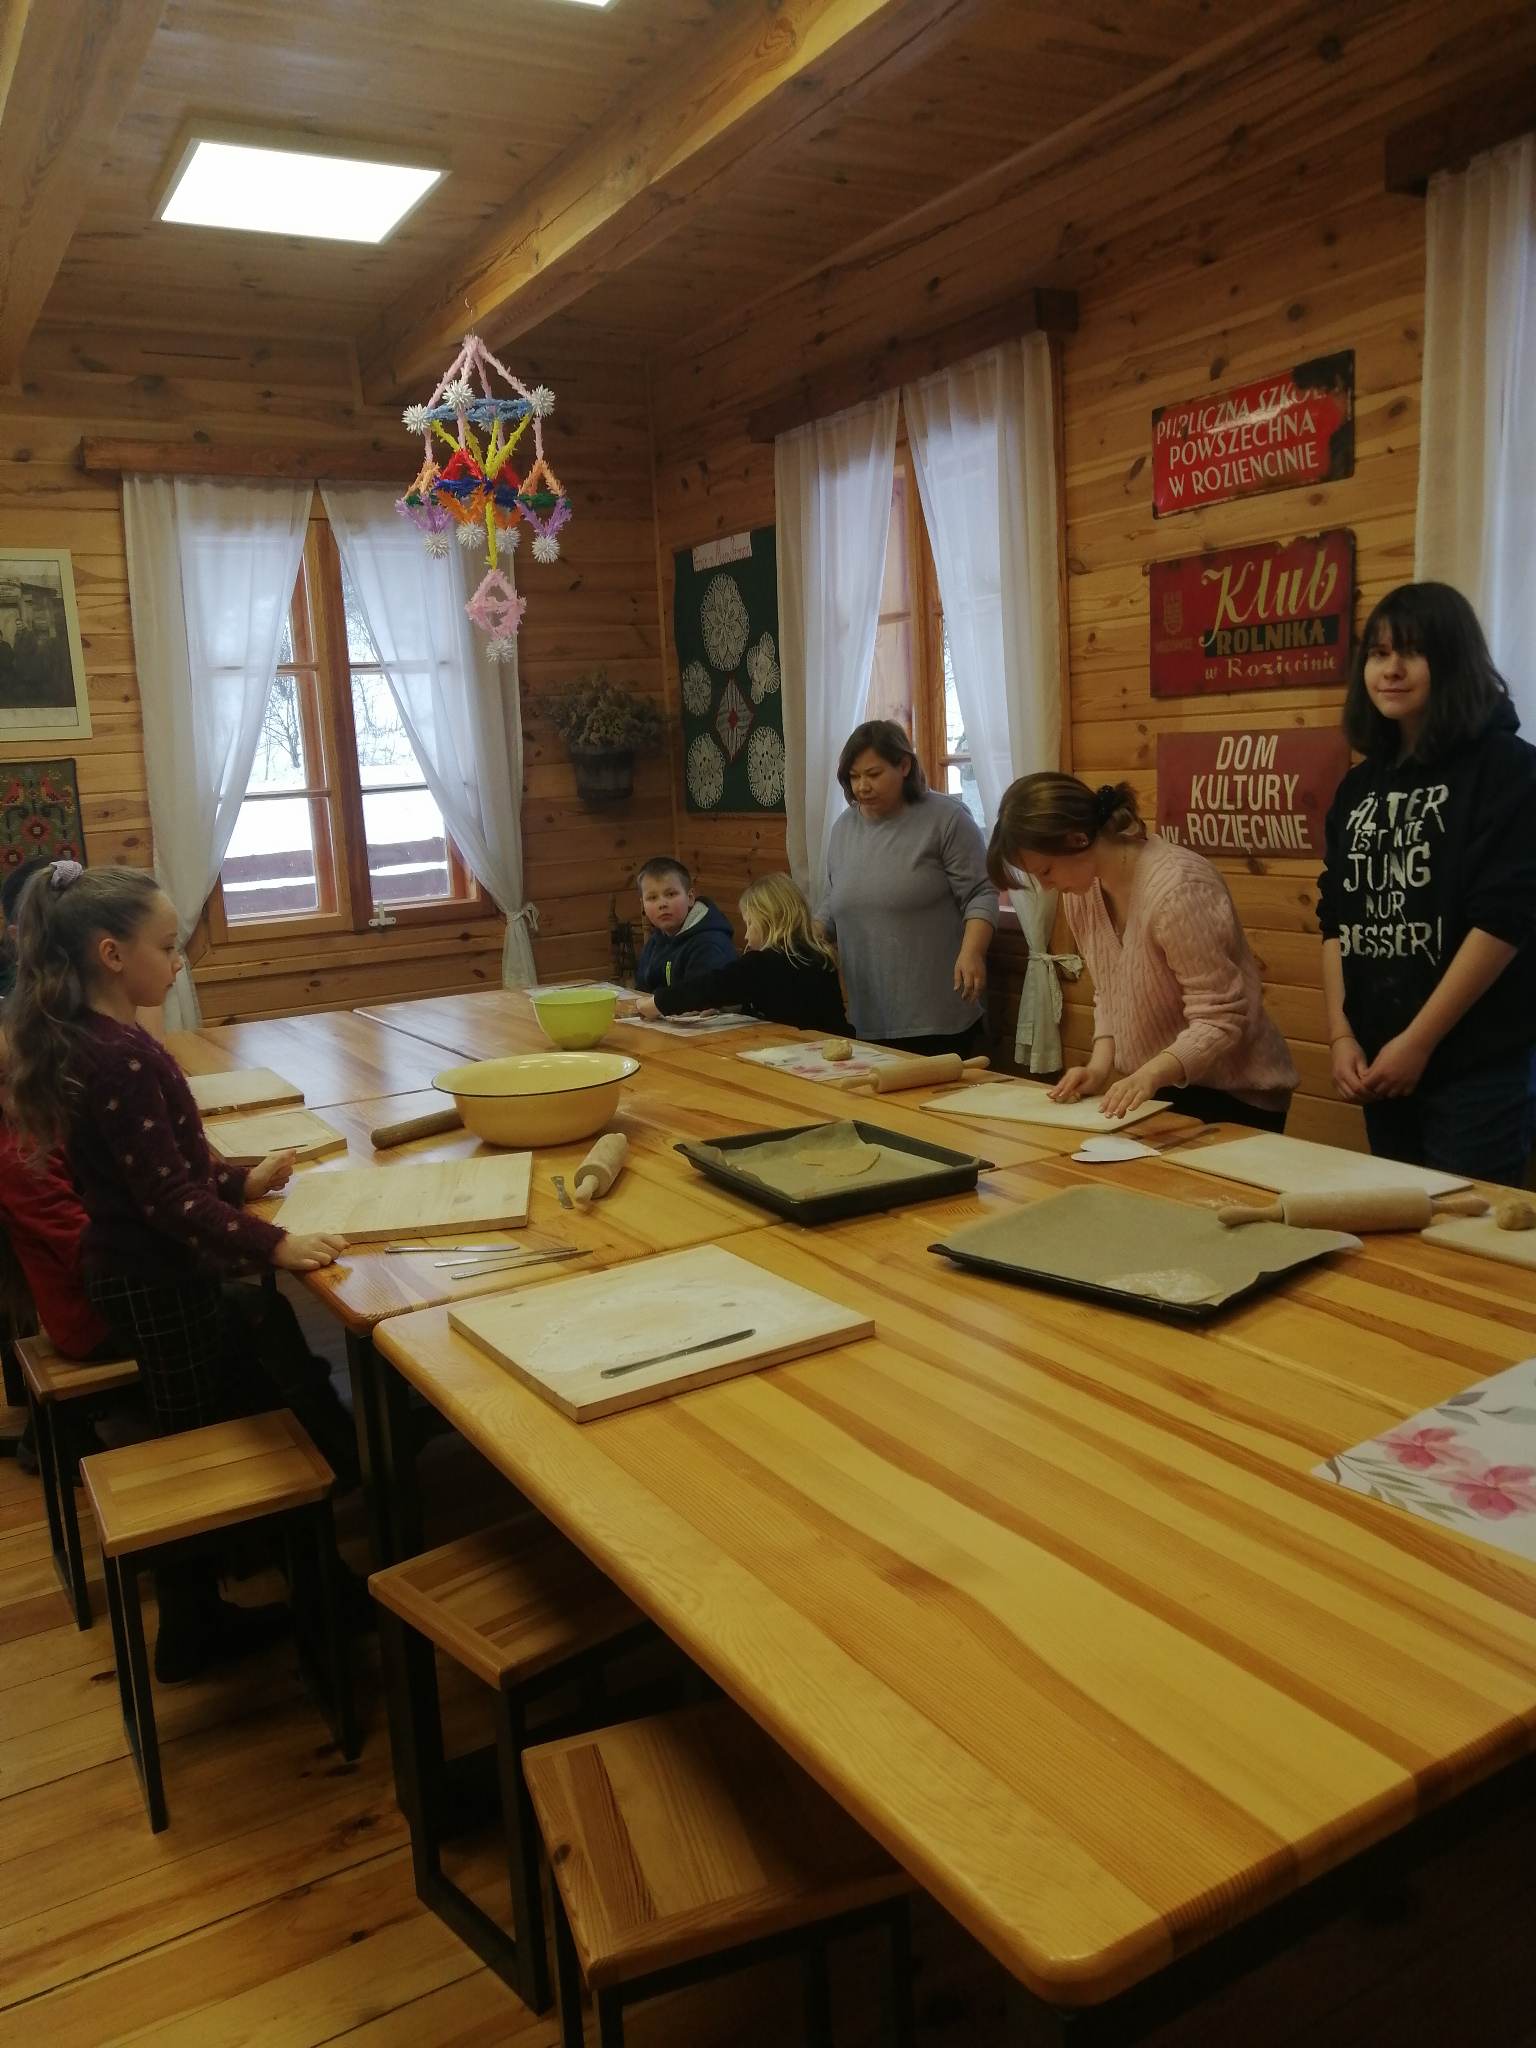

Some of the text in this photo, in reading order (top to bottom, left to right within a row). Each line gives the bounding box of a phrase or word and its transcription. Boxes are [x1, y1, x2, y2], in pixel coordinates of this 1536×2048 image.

[1169, 409, 1316, 469] POWSZECHNA
[1168, 441, 1319, 498] W ROZIENCINIE
[1199, 548, 1338, 647] Klub
[1216, 619, 1326, 657] ROLNIKA
[1216, 735, 1279, 770] DOM
[1191, 774, 1299, 811] KULTURY
[1346, 784, 1449, 833] ÄLTER
[1187, 813, 1312, 854] ROZIĘCINIE
[1350, 820, 1425, 851] IST NIE
[1343, 841, 1432, 892] JUNG
[1366, 891, 1407, 925] NUR
[1338, 915, 1443, 966] BESSER!
